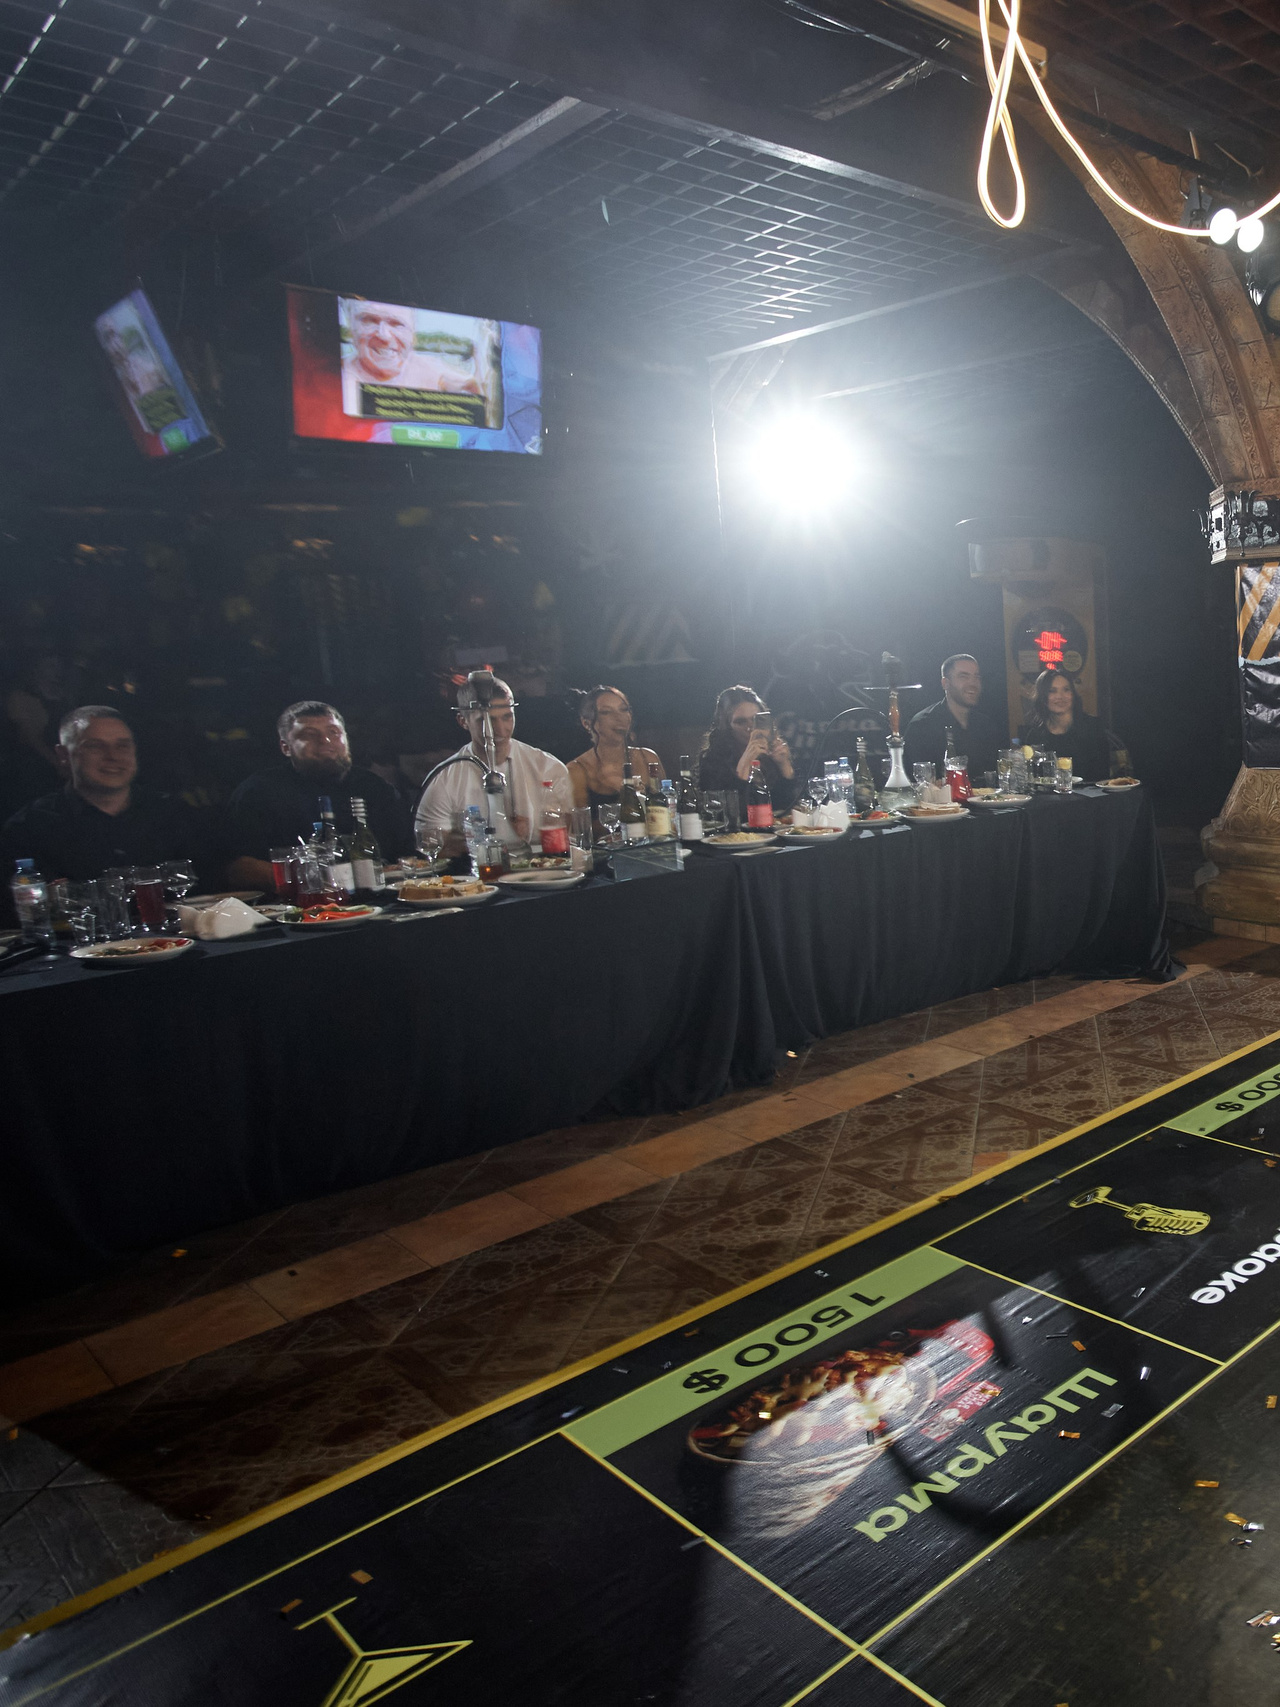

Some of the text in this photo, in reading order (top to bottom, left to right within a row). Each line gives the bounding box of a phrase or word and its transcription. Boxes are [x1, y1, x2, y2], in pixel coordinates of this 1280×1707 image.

[1215, 1101, 1245, 1113] $
[682, 1292, 886, 1394] 1500 $
[853, 1367, 1118, 1543] Шаурма
